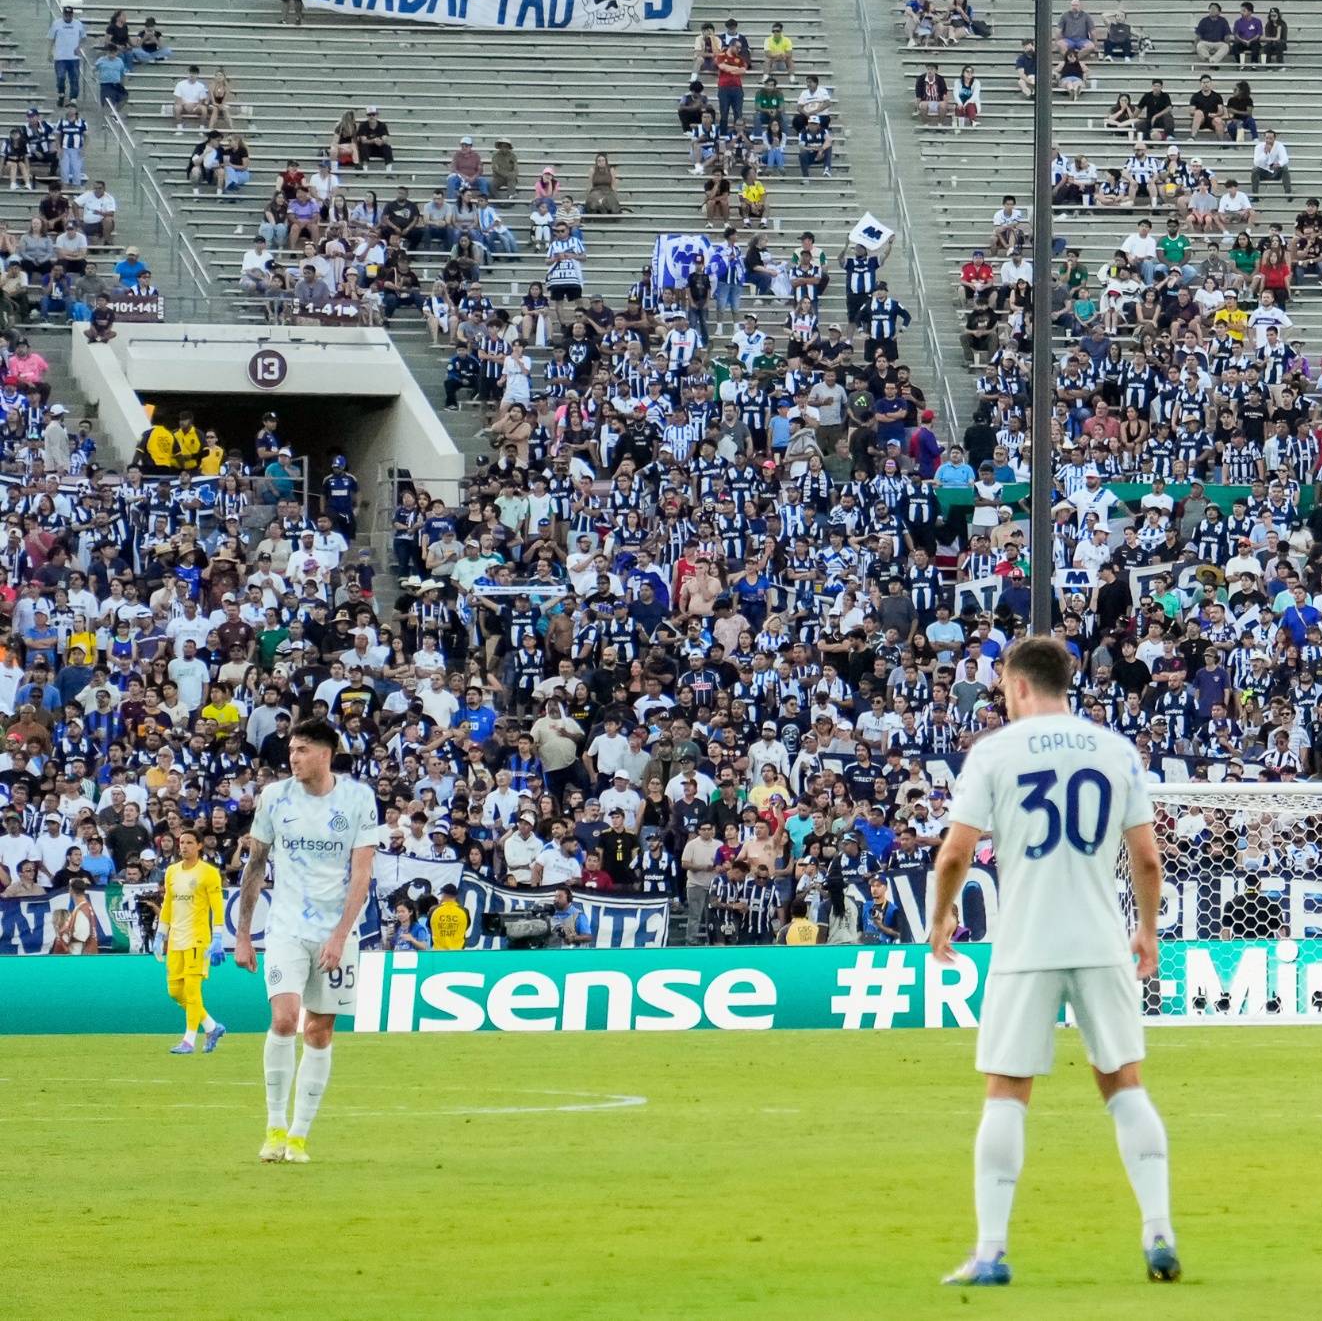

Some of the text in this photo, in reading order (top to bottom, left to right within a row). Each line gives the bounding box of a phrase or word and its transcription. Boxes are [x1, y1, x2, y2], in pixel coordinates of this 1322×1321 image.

[305, 303, 342, 316] 1-41
[256, 358, 280, 380] 13
[1028, 734, 1097, 755] CARLOS
[1017, 767, 1112, 860] 30
[282, 835, 344, 852] betsson
[171, 893, 194, 902] etsson
[439, 915, 458, 923] CSC
[191, 947, 198, 960] 1
[328, 965, 355, 990] 95
